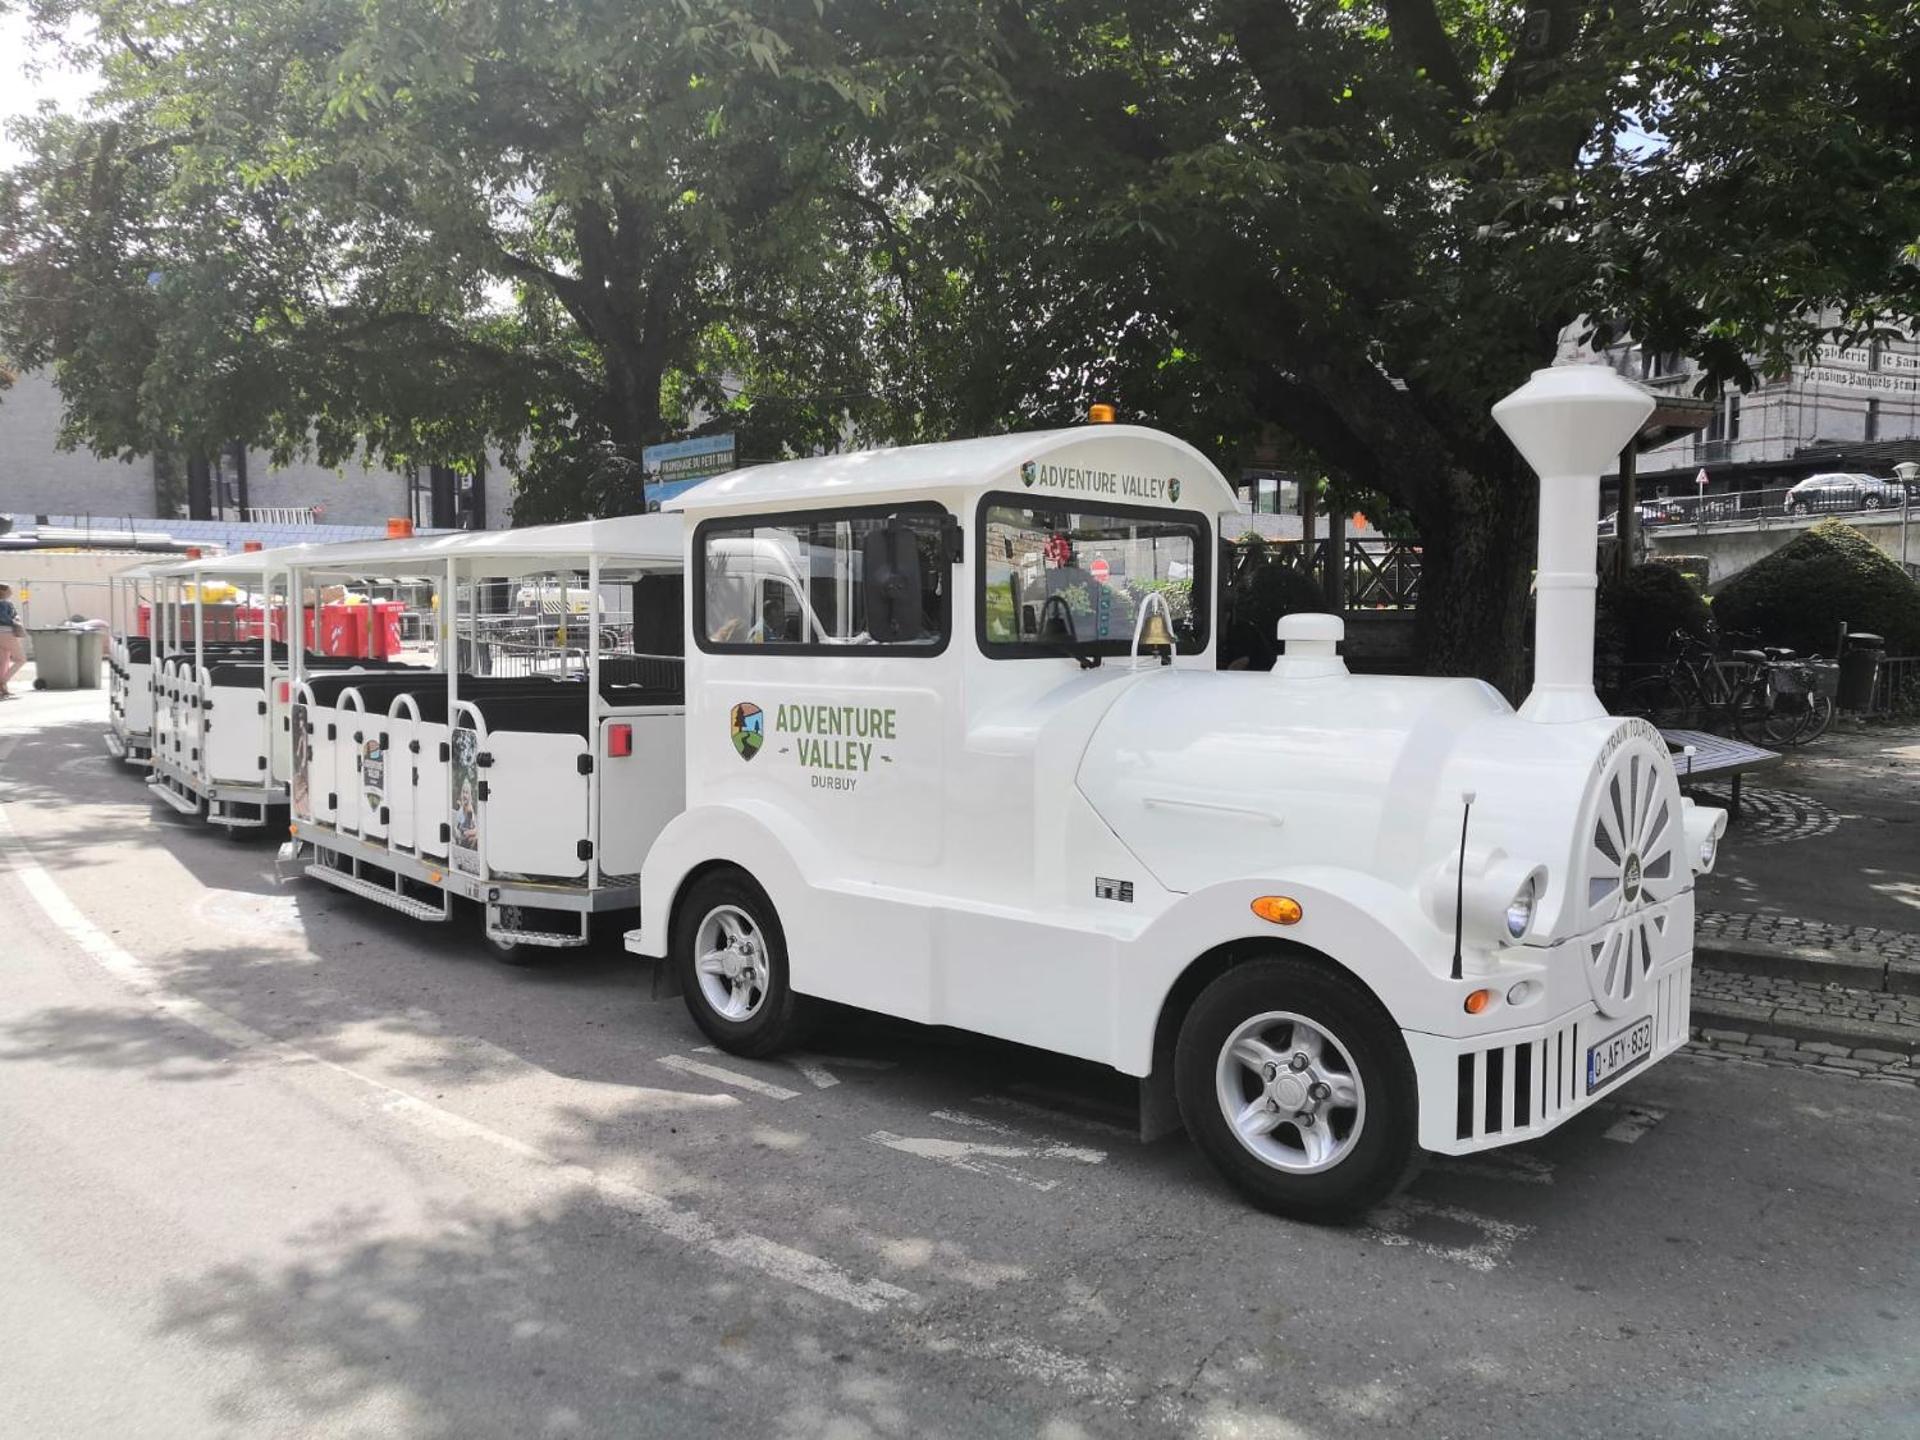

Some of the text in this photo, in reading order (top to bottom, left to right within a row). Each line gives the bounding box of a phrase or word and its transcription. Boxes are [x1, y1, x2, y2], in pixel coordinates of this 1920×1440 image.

[717, 450, 733, 465] TRAIN
[1039, 464, 1165, 499] ADVENTURE VALLEY
[776, 703, 897, 740] ADVENTURE
[797, 738, 873, 772] VALLEY
[1605, 722, 1629, 757] TRAIN
[811, 775, 857, 792] DURBUY
